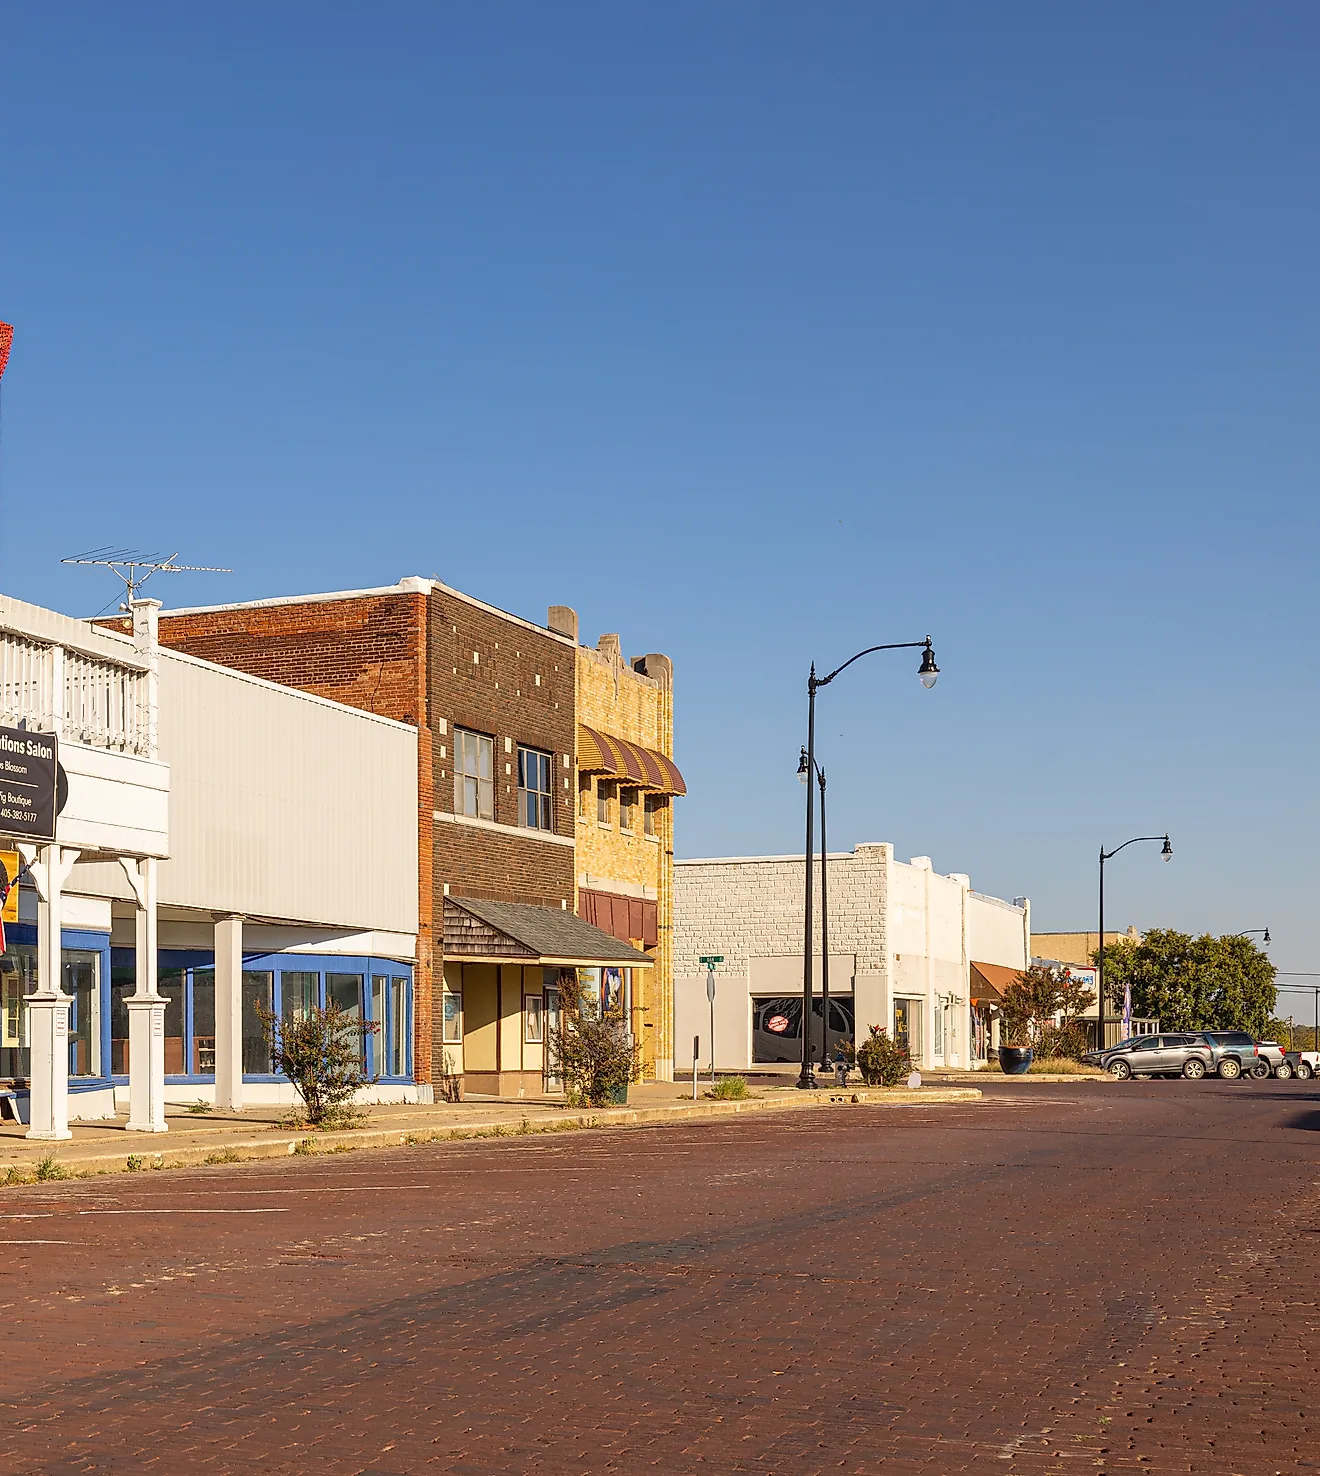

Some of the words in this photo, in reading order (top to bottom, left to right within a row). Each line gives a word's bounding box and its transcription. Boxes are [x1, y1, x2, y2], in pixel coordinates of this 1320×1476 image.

[26, 740, 53, 760] Salon
[4, 760, 28, 775] Blossom
[7, 791, 32, 808] Boutique
[0, 808, 38, 823] 405-382-5177
